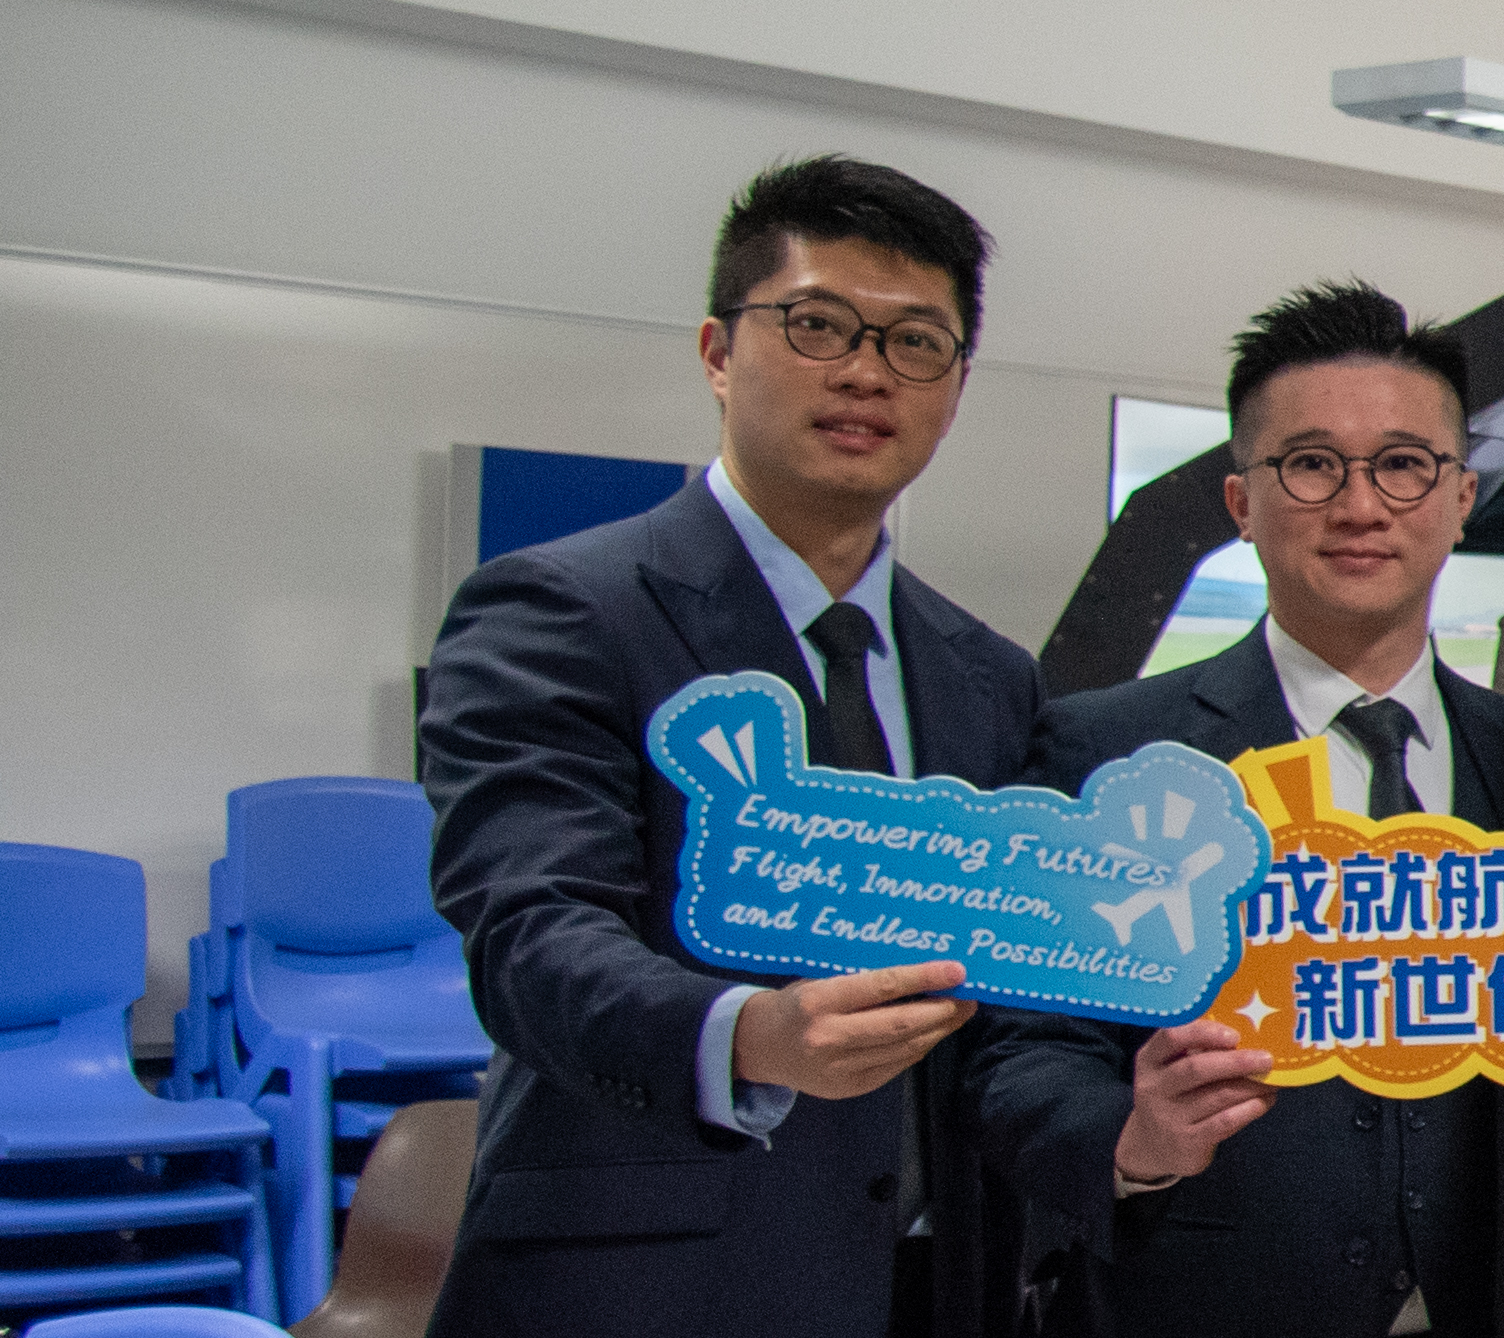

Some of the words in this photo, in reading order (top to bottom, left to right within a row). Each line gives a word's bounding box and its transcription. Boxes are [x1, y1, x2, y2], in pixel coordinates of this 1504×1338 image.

[735, 793, 992, 873] Empowering
[1006, 833, 1172, 888] Futures
[730, 845, 849, 894] Flight,
[862, 865, 1064, 926] Innovation,
[723, 898, 798, 930] and
[811, 905, 955, 954] Endless
[967, 929, 1177, 986] Possibilities
